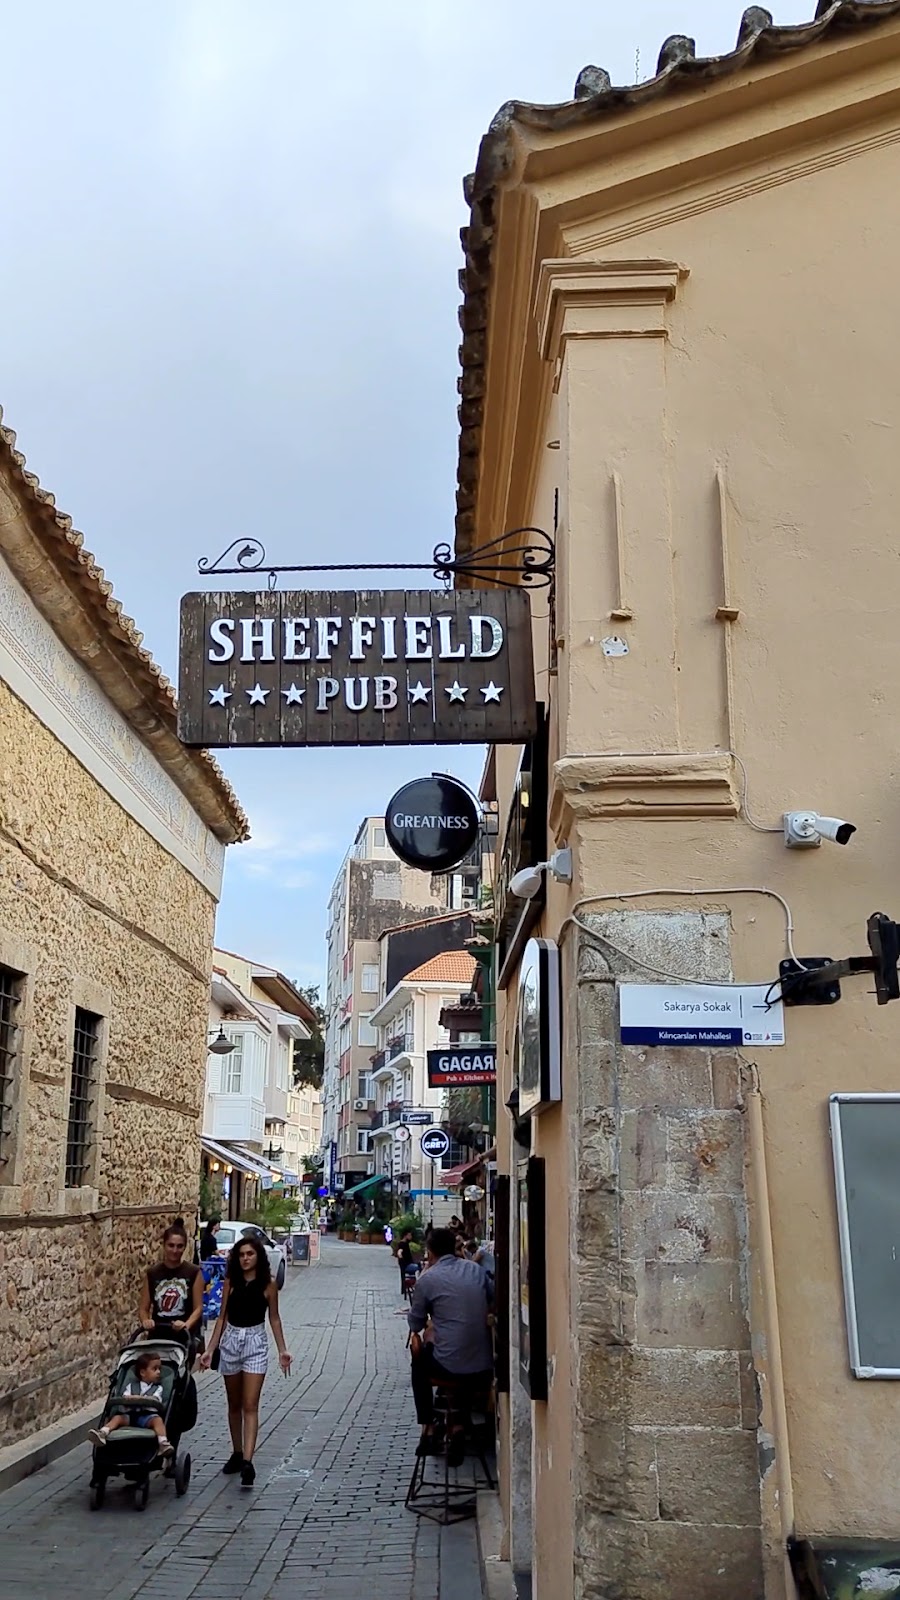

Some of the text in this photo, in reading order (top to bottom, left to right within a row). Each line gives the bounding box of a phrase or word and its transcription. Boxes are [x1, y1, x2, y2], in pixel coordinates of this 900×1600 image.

[208, 615, 504, 662] SHEFFIELD
[316, 676, 398, 711] PUB
[664, 1001, 731, 1014] Sakarya Sokak
[699, 1031, 731, 1040] Mahallesi
[424, 1141, 447, 1149] GREY
